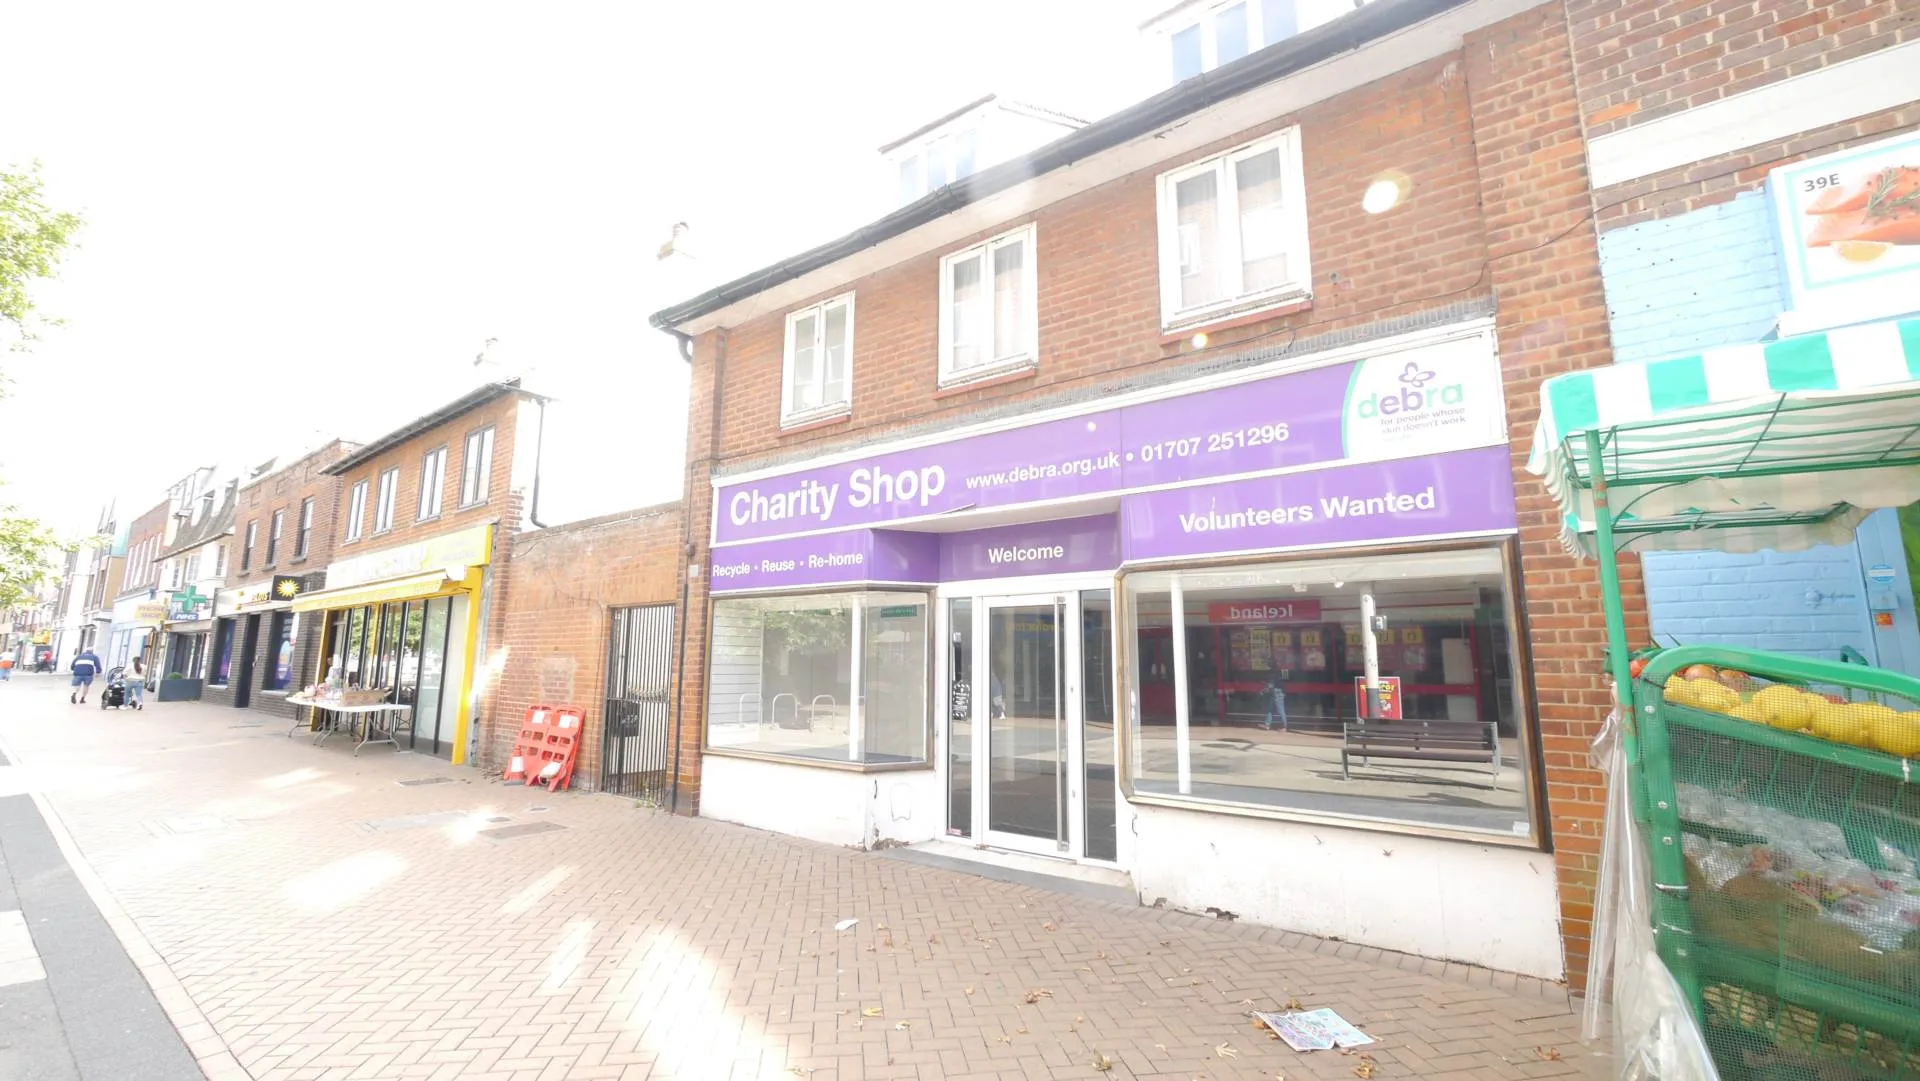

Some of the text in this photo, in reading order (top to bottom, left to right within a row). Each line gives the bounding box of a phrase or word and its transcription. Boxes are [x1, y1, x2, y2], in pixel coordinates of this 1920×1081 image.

[1804, 173, 1840, 192] 39E
[1358, 384, 1463, 418] debra
[1397, 413, 1430, 425] people
[1140, 422, 1290, 463] 01707 251296
[966, 451, 1120, 489] www.debra.org.uk
[729, 463, 946, 527] Charity Shop
[1179, 486, 1436, 534] Volunteers Wanted
[712, 550, 863, 578] Recycle Reuse Re-home
[988, 542, 1064, 565] Welcome
